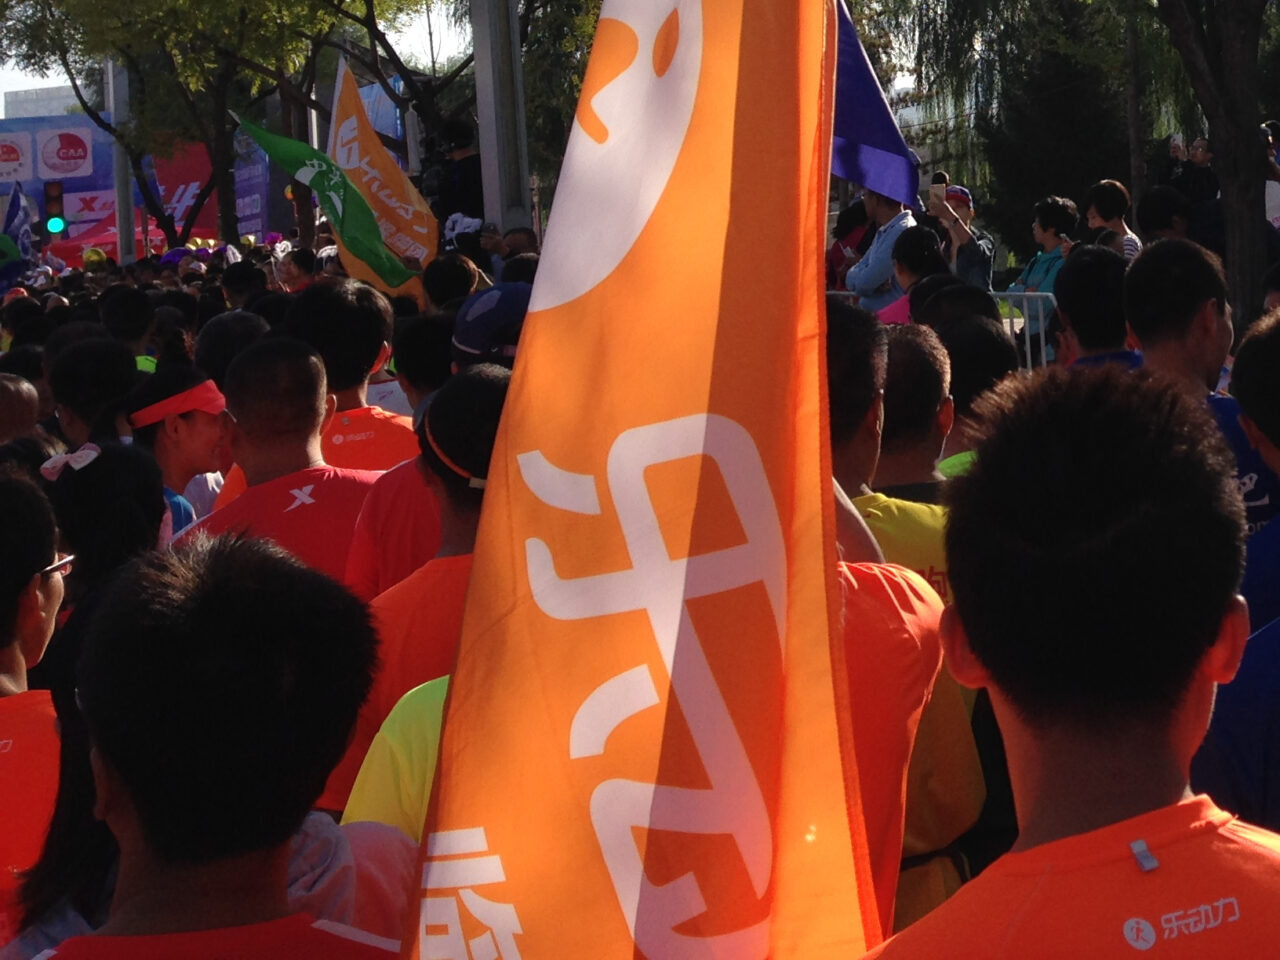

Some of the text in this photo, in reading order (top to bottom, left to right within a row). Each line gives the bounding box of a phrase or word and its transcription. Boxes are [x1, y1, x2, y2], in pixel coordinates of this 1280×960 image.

[59, 147, 85, 159] CAA
[1160, 896, 1241, 940] 乐动力
